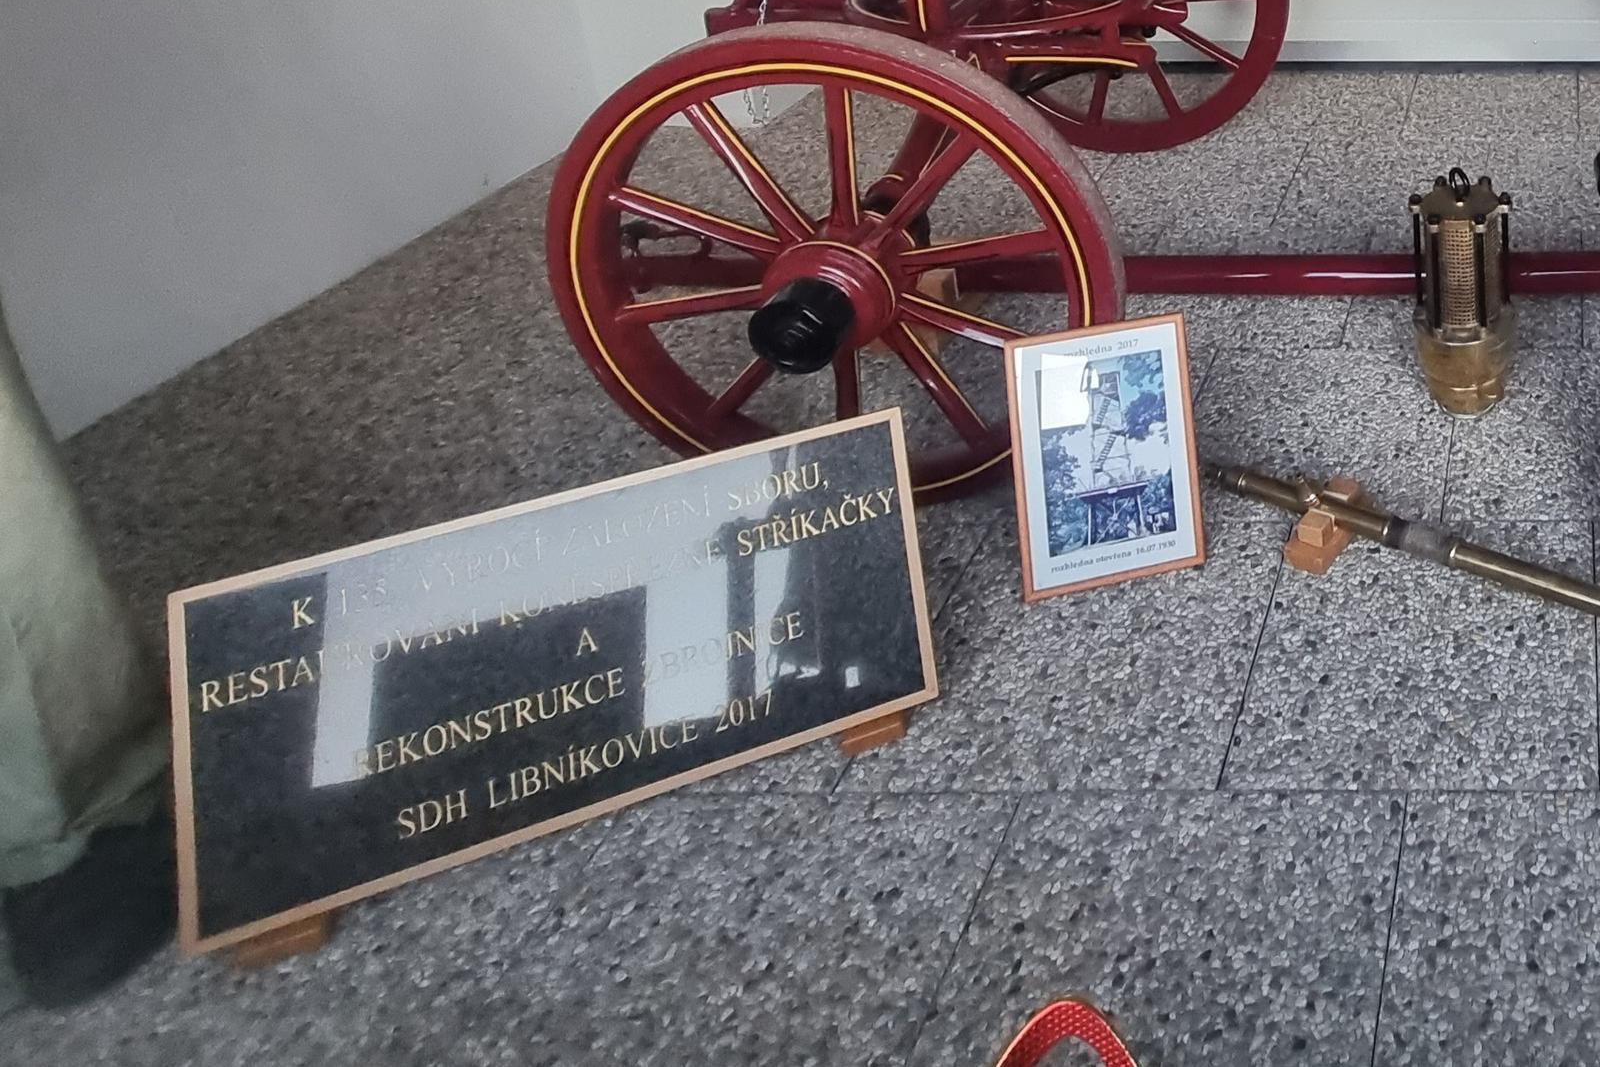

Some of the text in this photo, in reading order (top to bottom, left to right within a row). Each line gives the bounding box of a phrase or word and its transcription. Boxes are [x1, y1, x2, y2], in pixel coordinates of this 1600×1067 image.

[1117, 338, 1139, 350] 2017
[737, 486, 896, 557] STŘÍKAČKY
[291, 596, 316, 629] K
[575, 627, 599, 657] A
[397, 689, 774, 840] SDH LIBNÍKOVICE 2017
